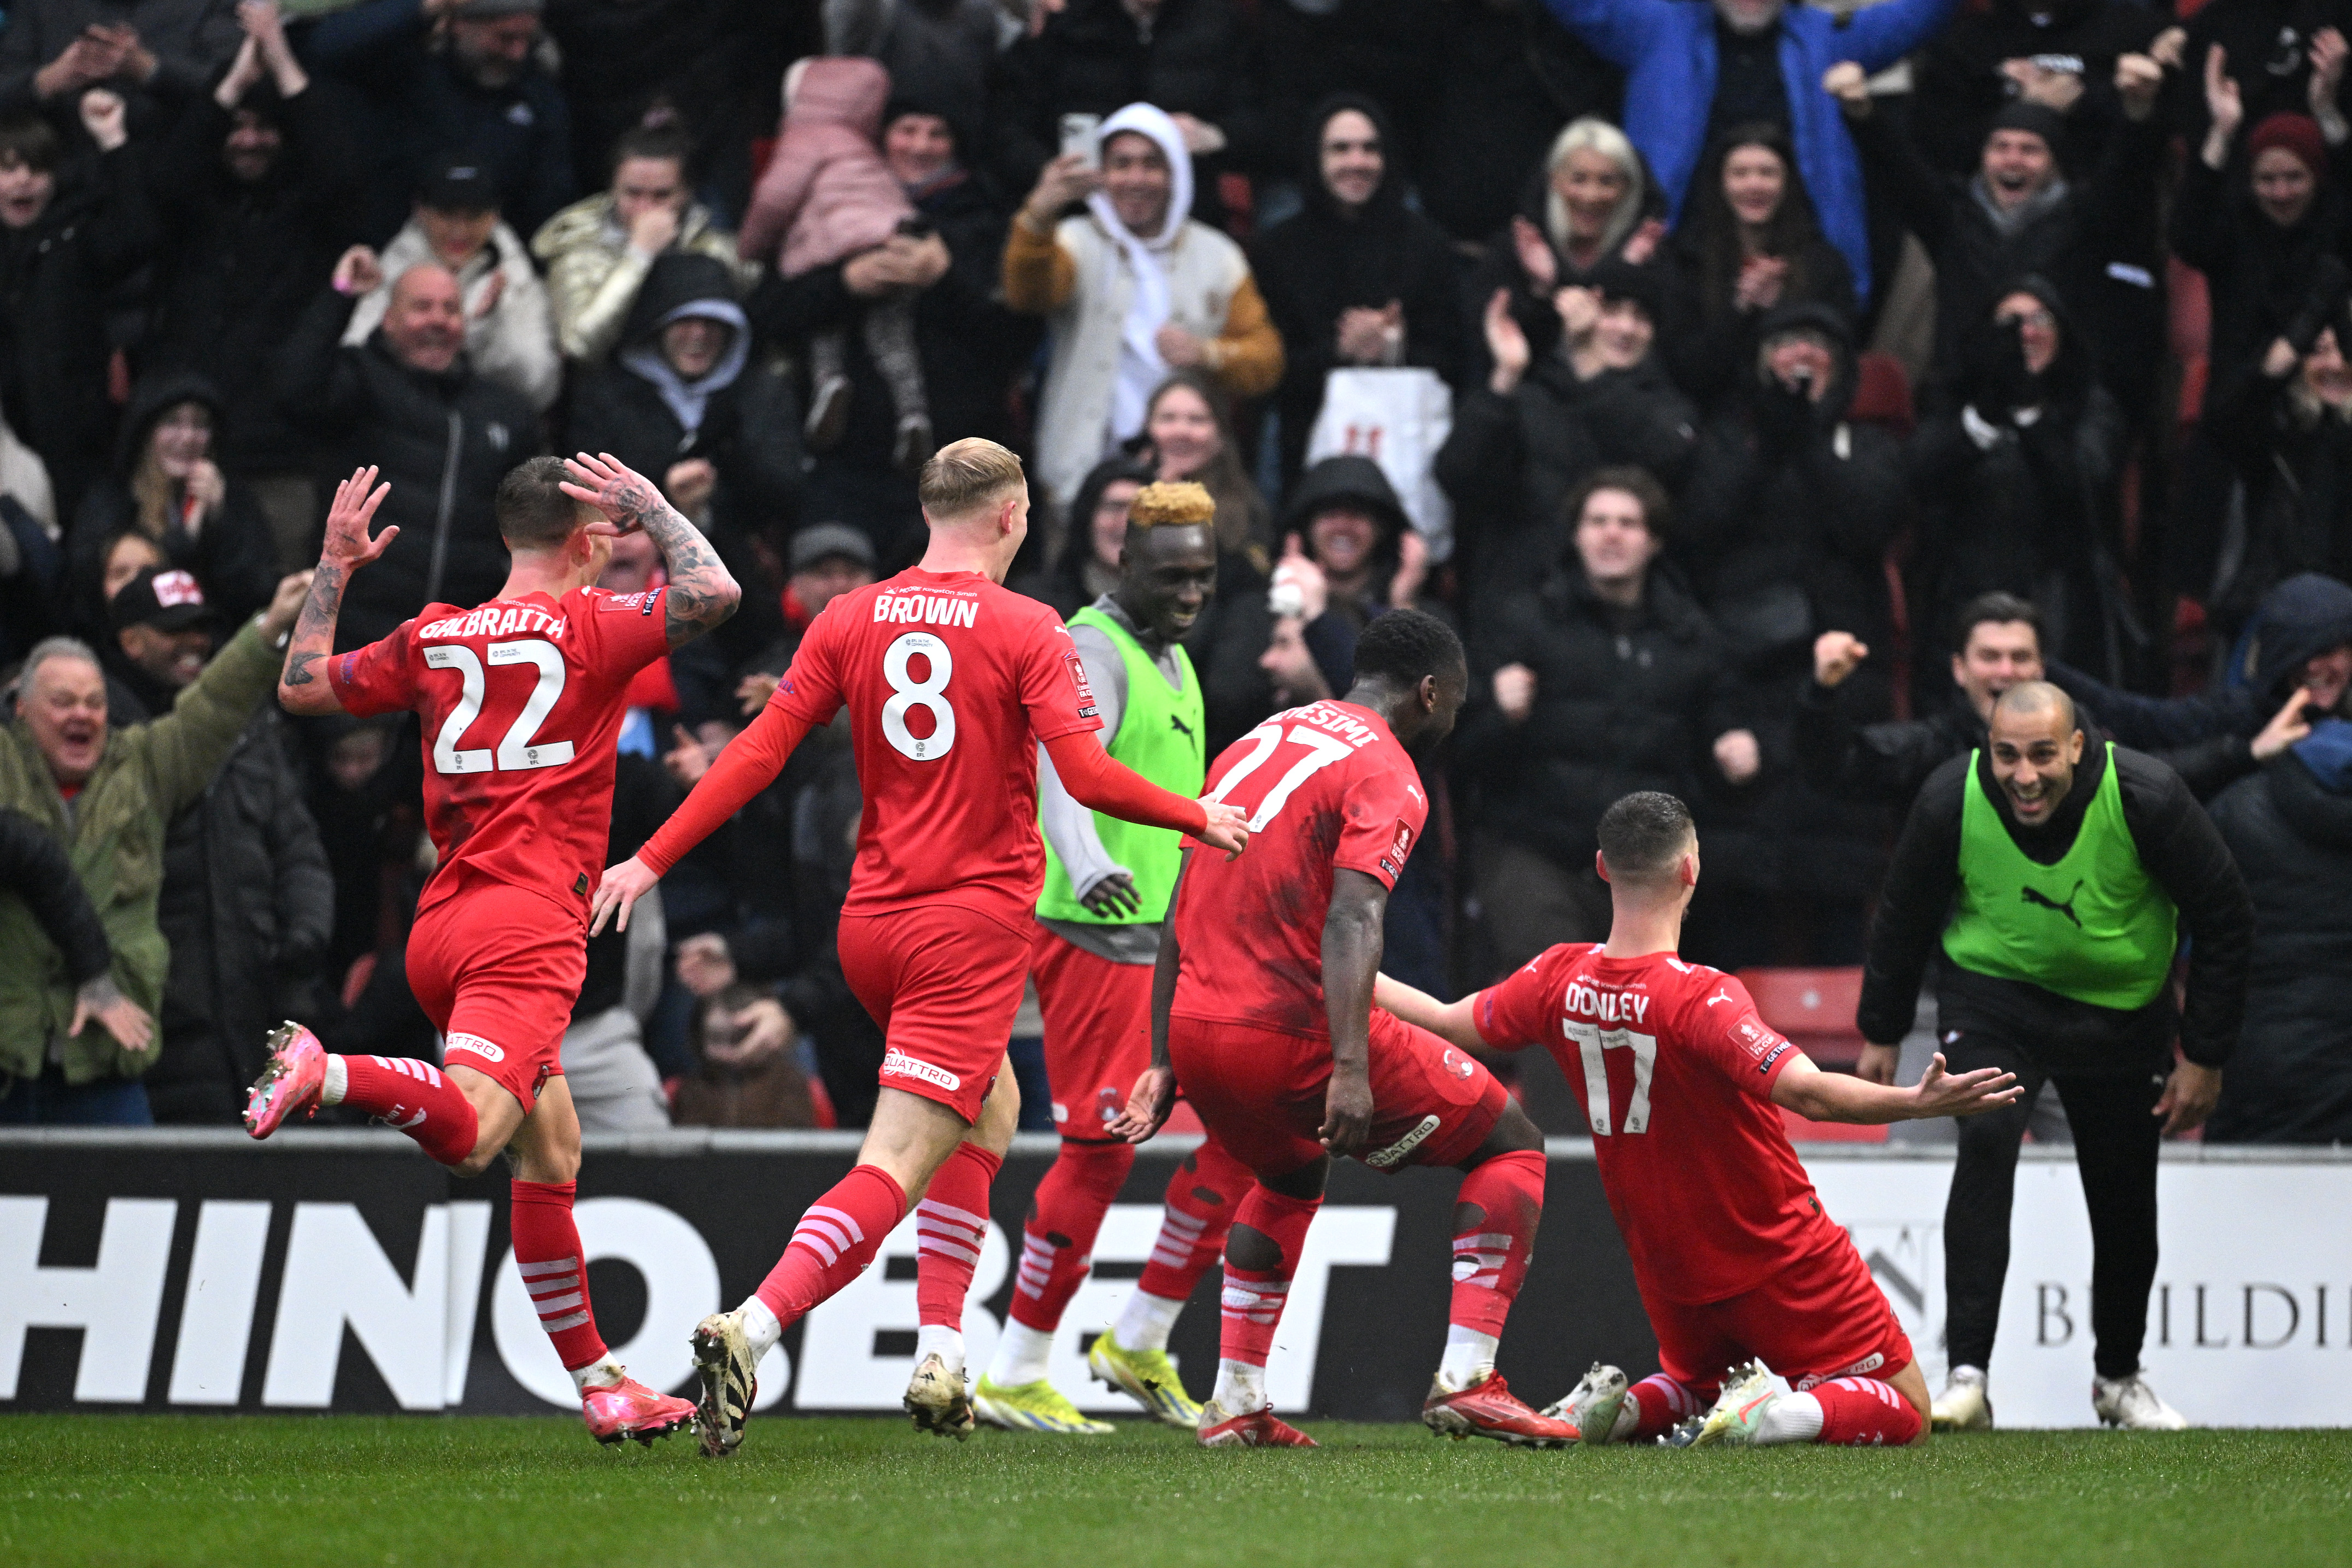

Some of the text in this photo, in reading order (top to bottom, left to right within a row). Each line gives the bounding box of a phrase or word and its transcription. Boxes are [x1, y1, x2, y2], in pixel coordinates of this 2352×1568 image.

[923, 587, 955, 595] Kingston
[419, 608, 567, 638] GALBRAITH
[873, 595, 979, 628] BROWN
[423, 638, 575, 774] 22
[882, 631, 955, 761] 8
[1213, 724, 1355, 833] 27
[1565, 982, 1650, 1024] DONLEY
[448, 1036, 496, 1057] ATTRO
[1753, 1036, 1774, 1056] FA CUP
[884, 1055, 952, 1085] QUATTRO
[1563, 1018, 1656, 1137] 17
[2034, 1281, 2352, 1349] BILDI
